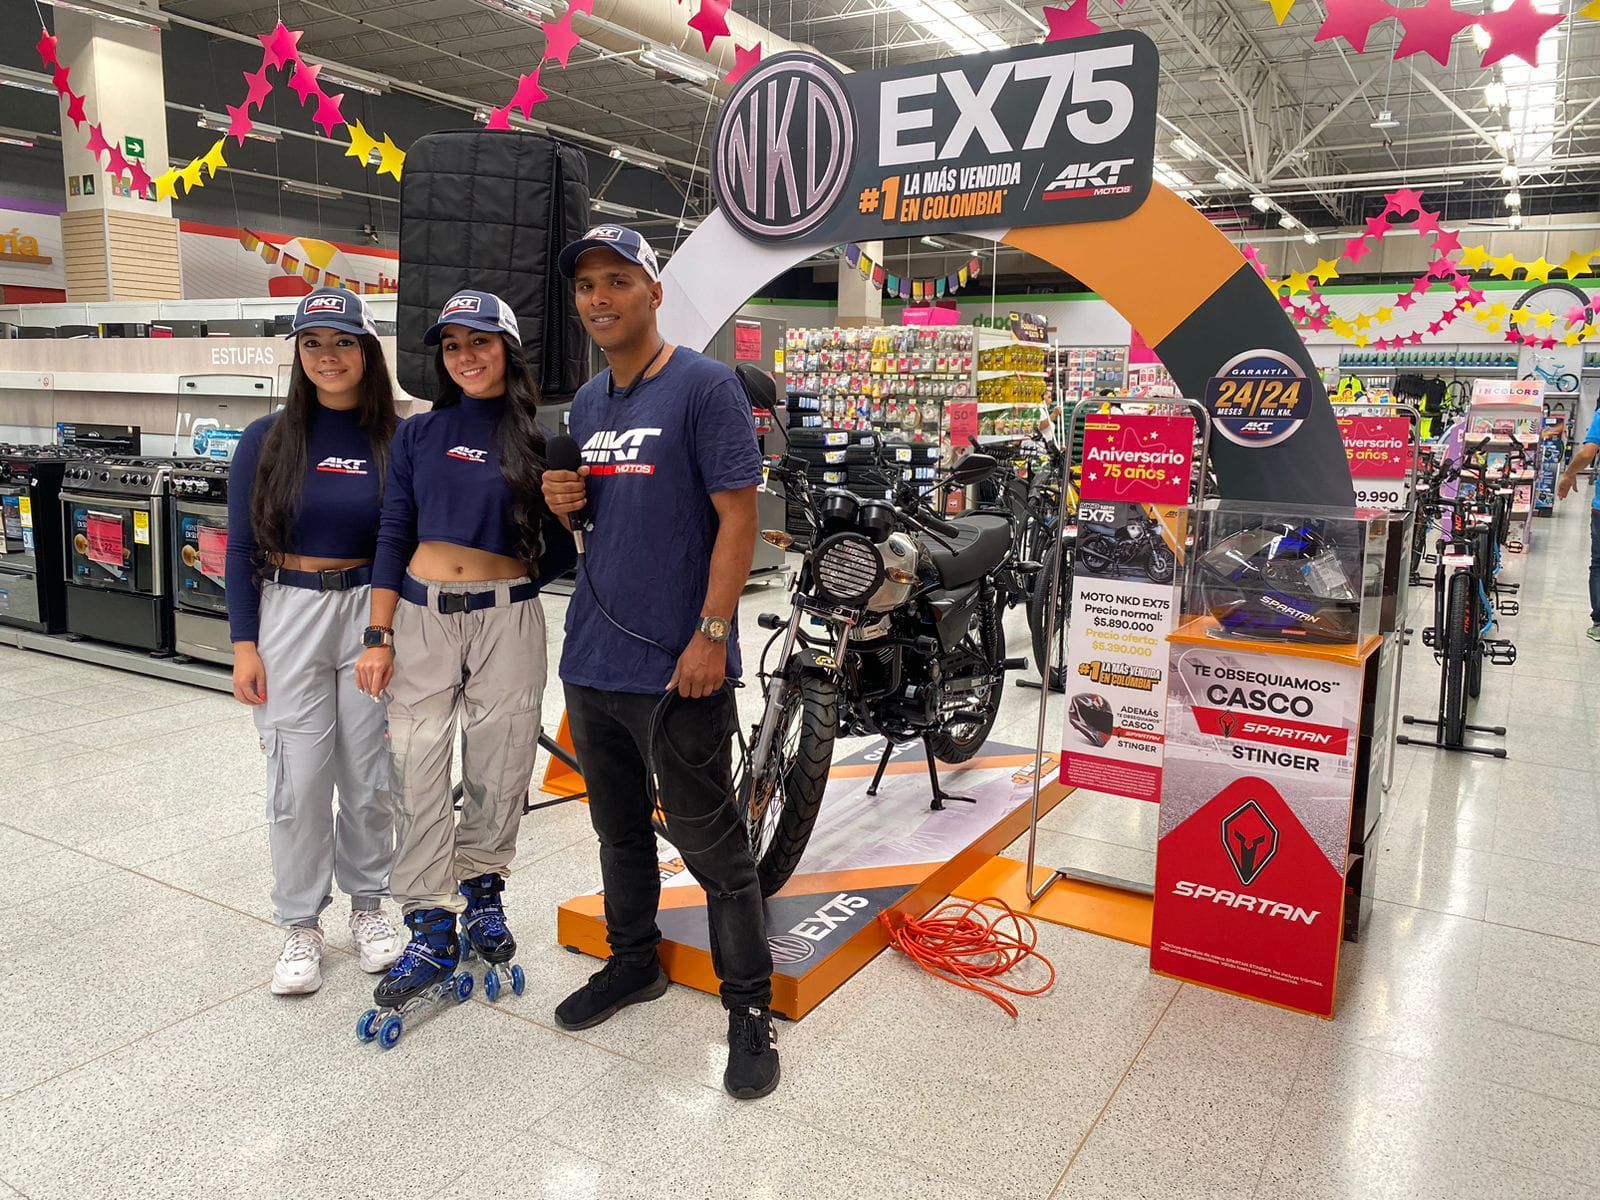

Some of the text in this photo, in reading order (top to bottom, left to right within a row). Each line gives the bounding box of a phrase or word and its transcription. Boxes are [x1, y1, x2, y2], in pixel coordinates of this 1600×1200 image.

[878, 44, 1135, 168] EX75
[727, 76, 840, 221] NKD
[903, 162, 1021, 196] LA MÁS VENDIDA
[1044, 158, 1134, 191] AKT
[859, 176, 900, 220] #1
[1093, 185, 1132, 196] MOTOS
[900, 198, 920, 222] EN
[309, 298, 343, 307] AKT
[211, 346, 274, 365] ESTUFAS
[1231, 368, 1288, 376] GARANTÍA
[1217, 407, 1243, 416] MESES
[1260, 408, 1276, 416] MIL
[1240, 422, 1274, 431] AKT
[580, 428, 663, 463] AKT
[1343, 436, 1403, 449] iversario
[449, 445, 488, 459] AKT
[1087, 446, 1185, 465] Aniversario
[1355, 448, 1388, 460] años
[318, 456, 367, 470] AKT
[615, 464, 651, 473] MOTOS
[1103, 463, 1166, 480] 75 años
[1078, 508, 1116, 523] EX75
[1080, 591, 1170, 610] MOTO NKD EX75
[1084, 604, 1163, 621] Precio normal:
[1259, 595, 1321, 624] SPARTAN
[1093, 616, 1154, 633] $5.890.000
[1085, 628, 1158, 646] Precio oferta:
[1092, 640, 1152, 657] $5.390.000
[1079, 660, 1101, 683] #1
[1101, 672, 1111, 684] EN
[1102, 661, 1161, 680] LA MÁS VENDIDA
[1193, 664, 1211, 677] TE
[1206, 684, 1314, 718] CASCO
[1120, 705, 1159, 718] ADEMÁS
[1121, 719, 1155, 731] CASCO
[1242, 722, 1333, 745] SPARTAN
[1117, 740, 1157, 753] STINGER
[1232, 745, 1320, 773] STINGER
[1171, 879, 1322, 925] SPARTAN
[788, 892, 870, 942] EX75
